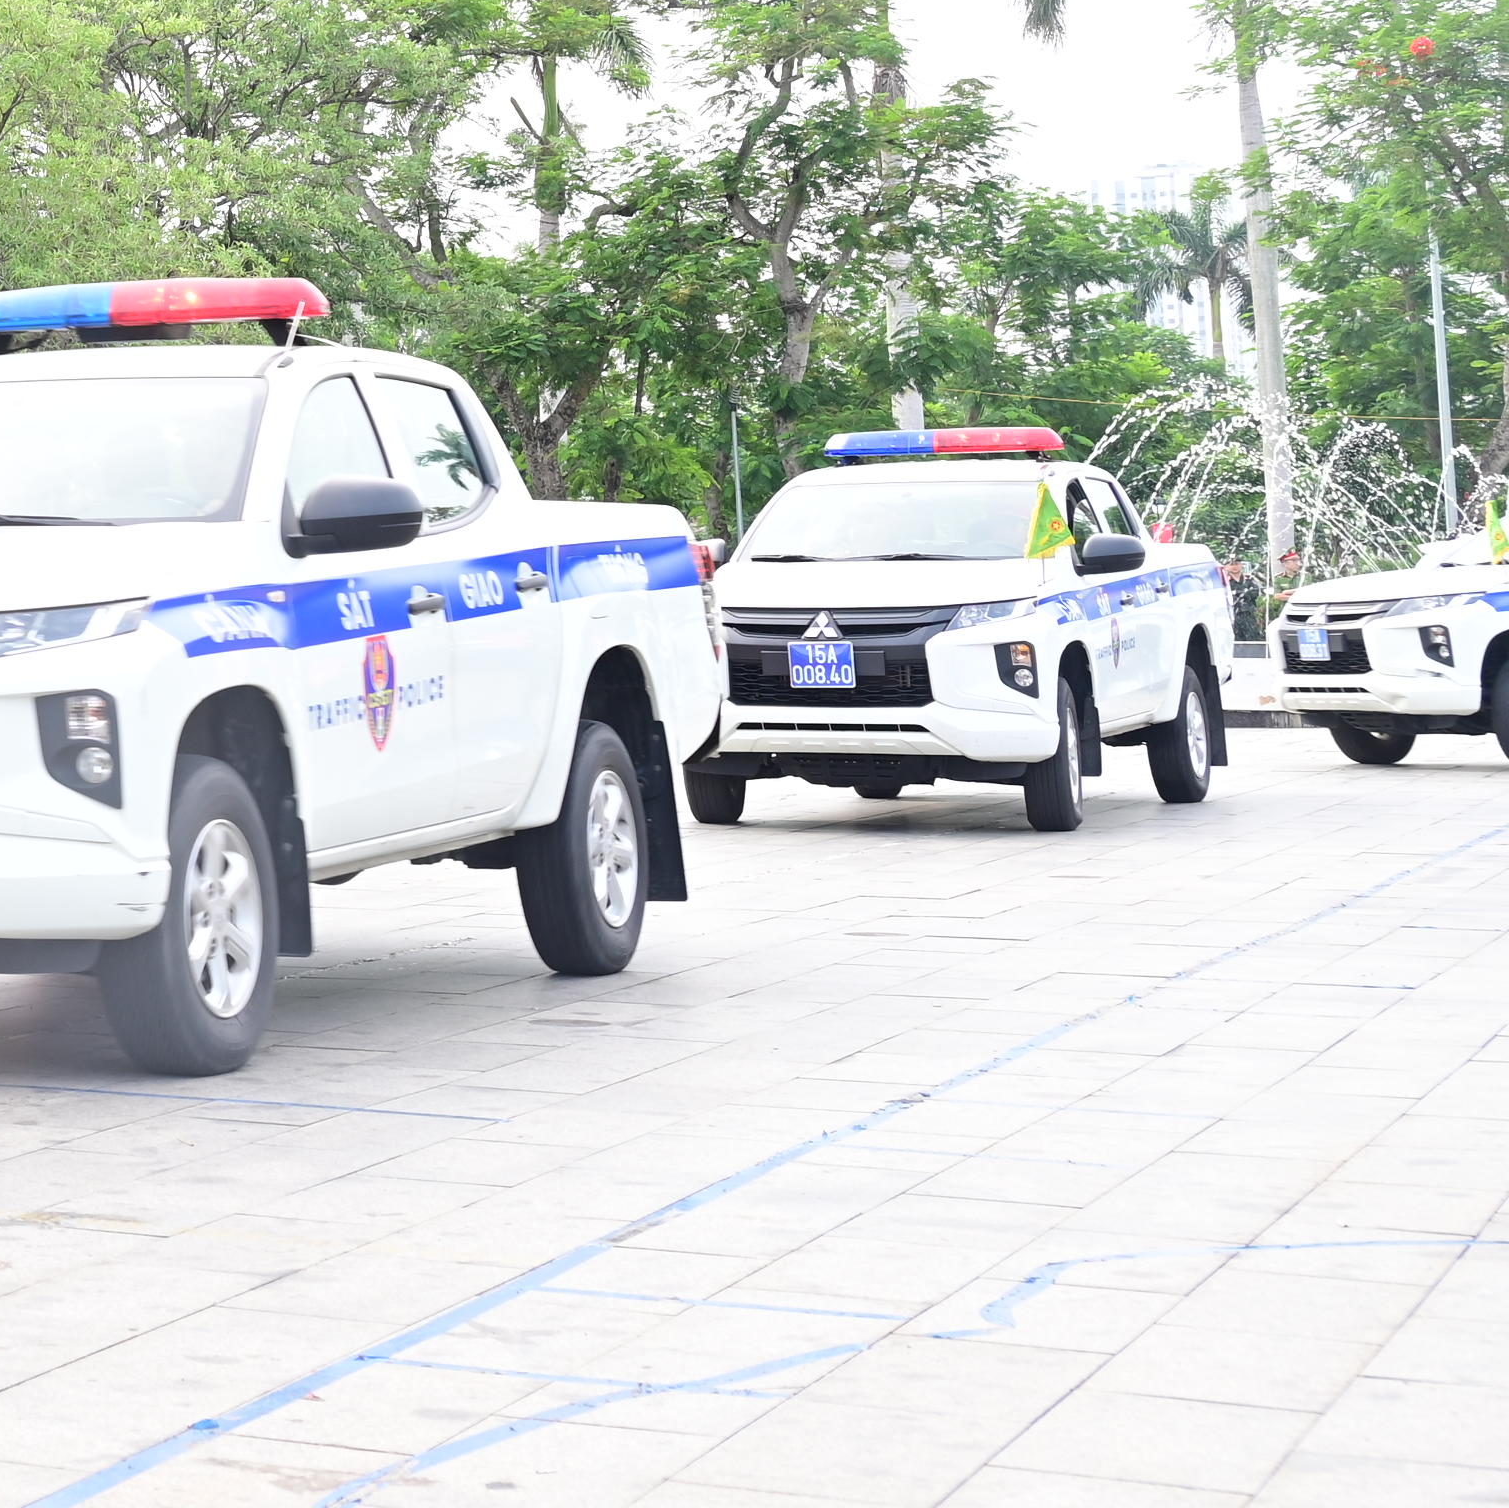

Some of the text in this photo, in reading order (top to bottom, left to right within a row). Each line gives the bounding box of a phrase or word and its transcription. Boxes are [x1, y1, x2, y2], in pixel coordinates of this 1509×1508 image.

[458, 570, 504, 610] GIAO
[805, 644, 838, 664] 15A
[792, 664, 853, 685] 008.40
